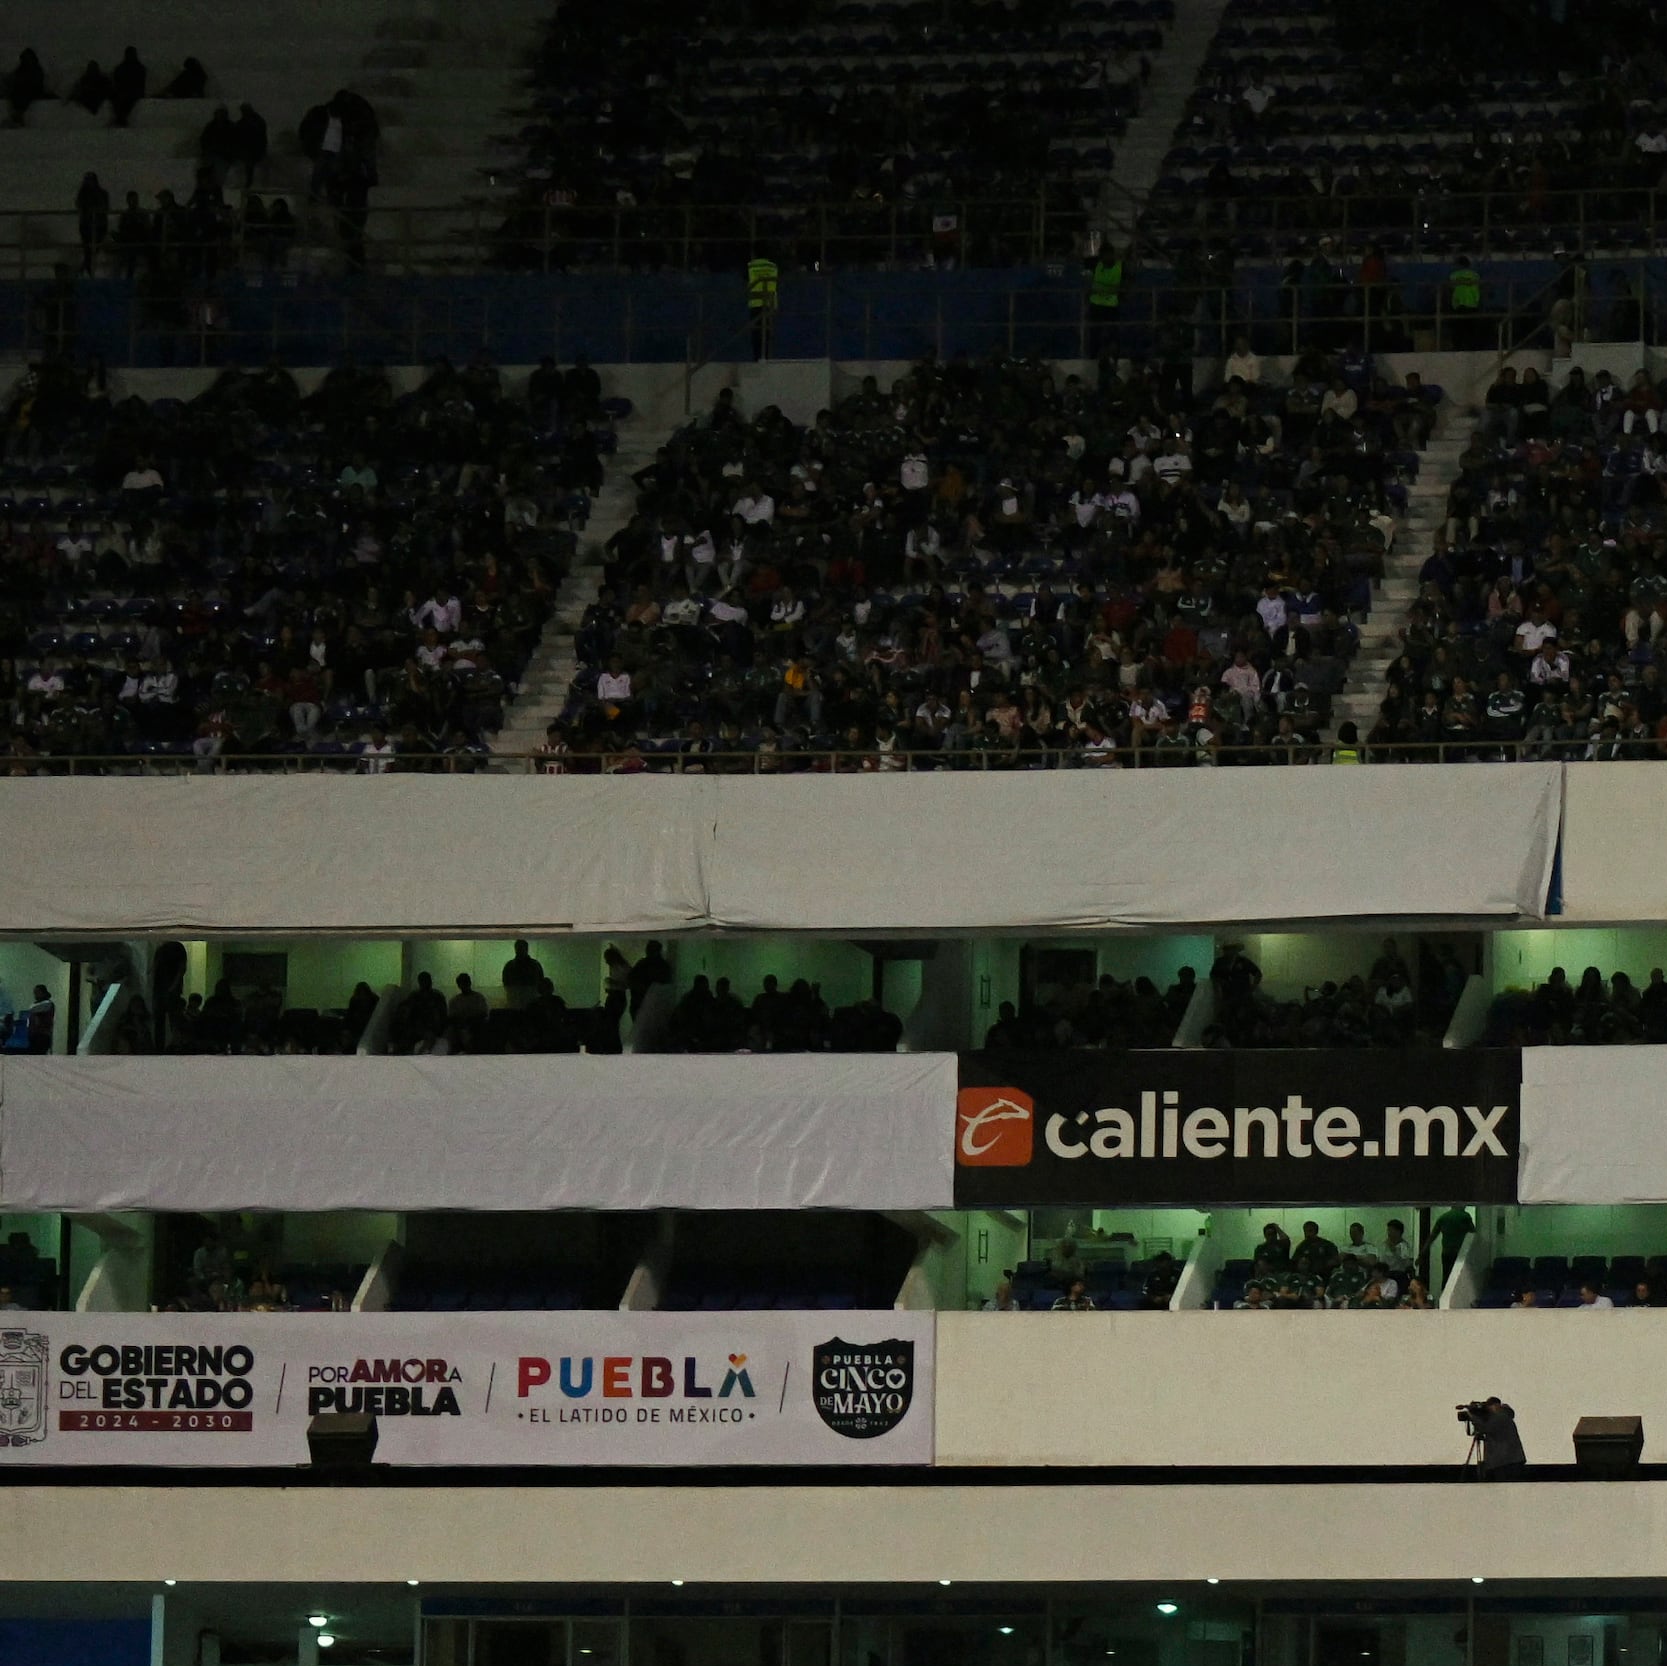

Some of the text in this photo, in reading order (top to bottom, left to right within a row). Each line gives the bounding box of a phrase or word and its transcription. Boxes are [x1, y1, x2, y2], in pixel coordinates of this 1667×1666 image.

[1044, 1091, 1509, 1159] caliente.mx
[60, 1344, 254, 1376] GOBIERNO
[833, 1354, 894, 1365] PUEBLA
[308, 1366, 348, 1383] POR
[517, 1353, 756, 1398] PUEBLA
[820, 1366, 906, 1391] CINCO
[59, 1378, 254, 1409] DEL ESTADO
[308, 1386, 462, 1416] PUEBLA
[820, 1393, 904, 1414] DE MAYO
[79, 1415, 139, 1428] 2024
[172, 1415, 234, 1428] 2030
[529, 1405, 744, 1423] EL LATIDO DE MÉXICO
